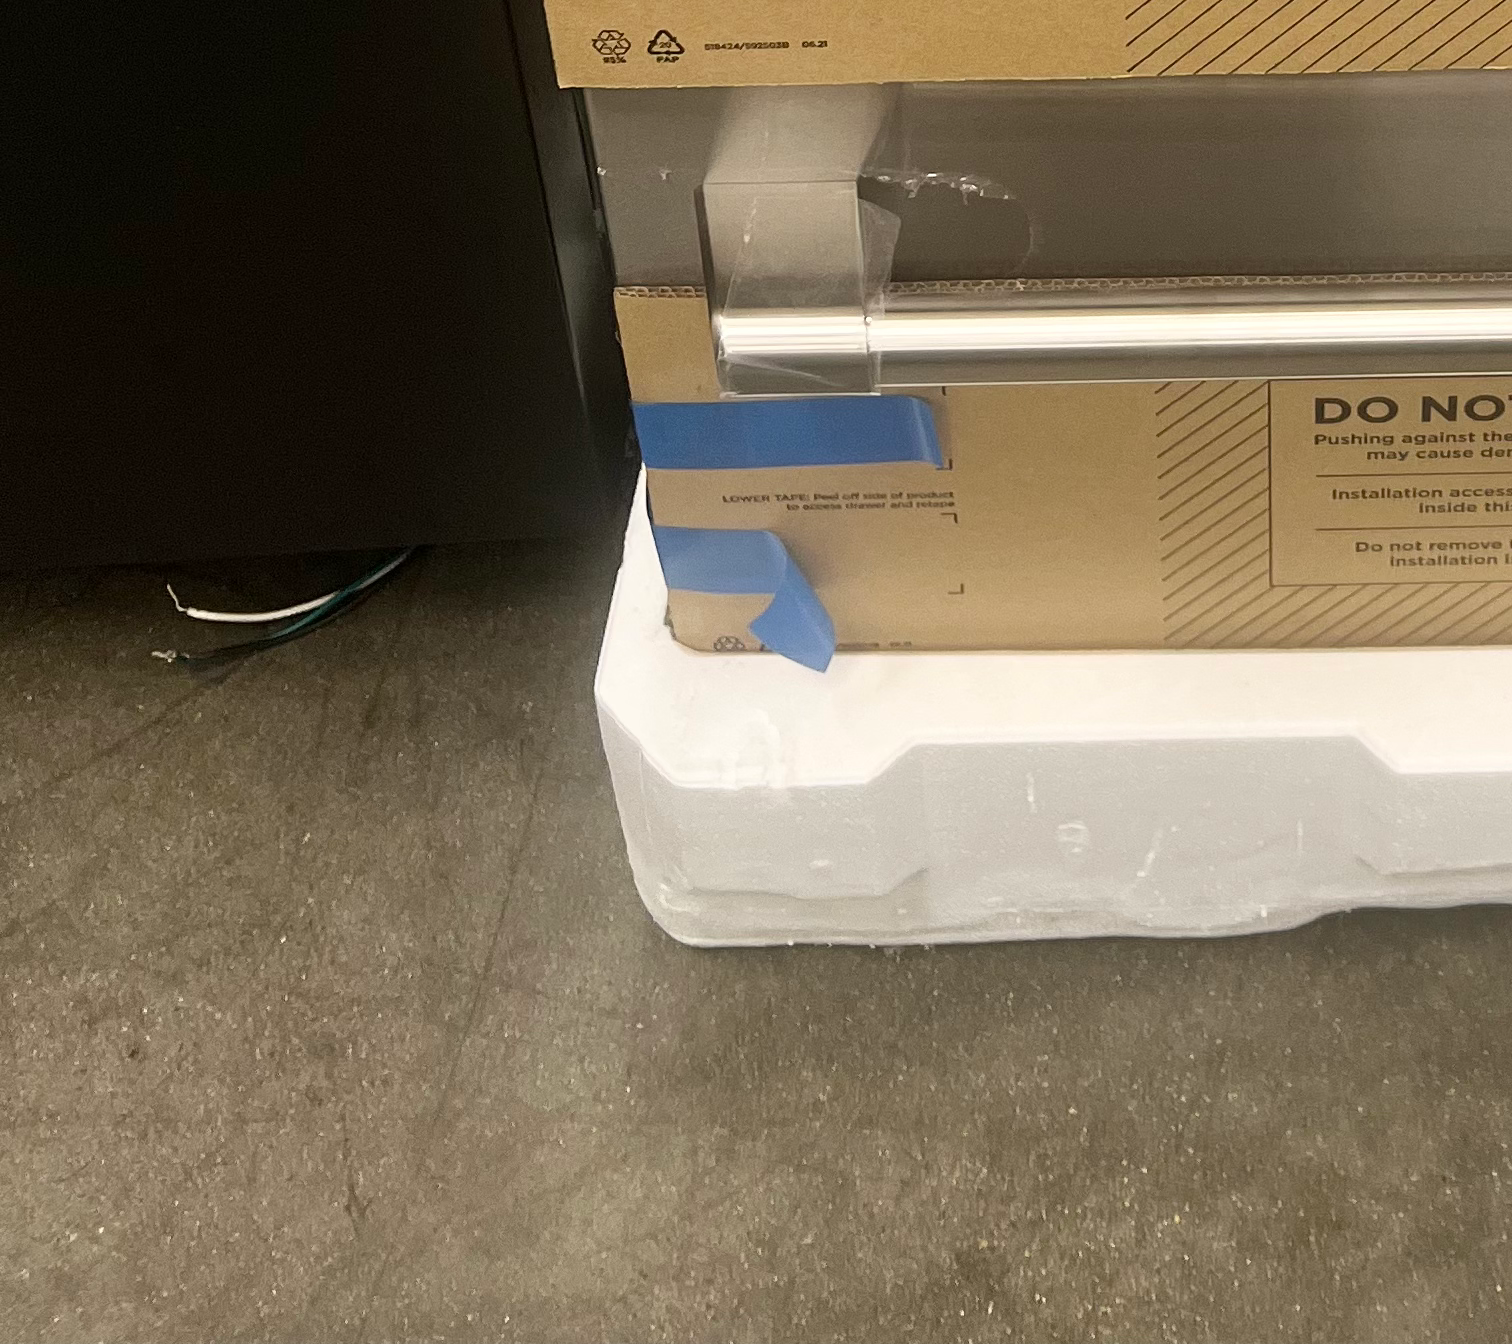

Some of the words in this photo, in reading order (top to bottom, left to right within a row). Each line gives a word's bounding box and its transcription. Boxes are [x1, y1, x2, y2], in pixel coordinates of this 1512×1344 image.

[1315, 396, 1399, 424] DO
[1314, 433, 1394, 446] Pushing
[1401, 432, 1476, 445] against
[1367, 451, 1409, 461] may
[1415, 450, 1474, 459] cause
[1332, 487, 1443, 500] Installation
[1419, 502, 1477, 513] inside
[1355, 542, 1383, 553] Do
[1390, 541, 1422, 552] not
[1429, 541, 1503, 551] remove
[1390, 554, 1498, 567] installation
